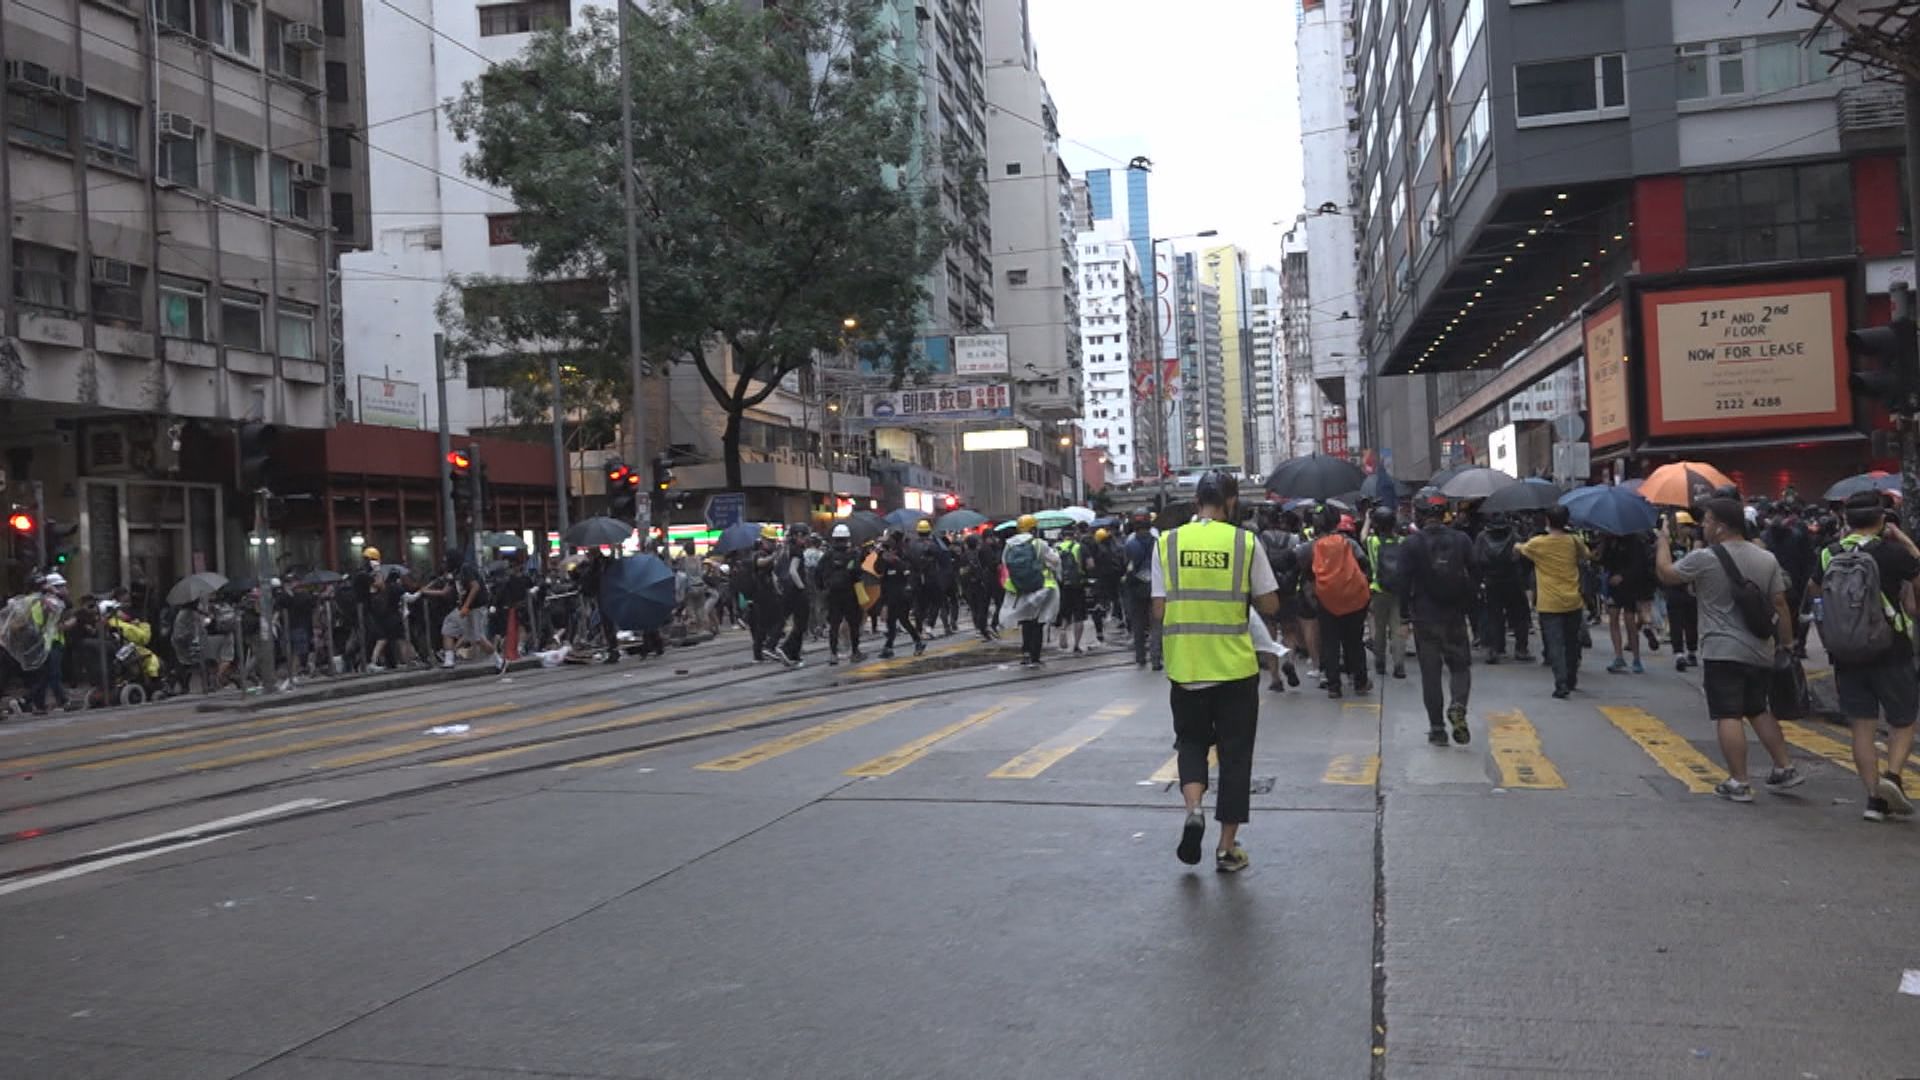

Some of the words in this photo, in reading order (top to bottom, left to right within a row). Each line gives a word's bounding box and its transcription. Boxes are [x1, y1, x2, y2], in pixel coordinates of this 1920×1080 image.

[1698, 309, 1726, 327] 1st
[1730, 313, 1755, 325] AND
[1760, 304, 1789, 323] 2nd
[1724, 324, 1766, 338] FLOOR
[1688, 348, 1716, 361] NOW
[1724, 346, 1751, 359] FOR
[1760, 342, 1805, 357] LEASE
[1716, 399, 1745, 410] 2122
[1183, 551, 1226, 568] PRESS
